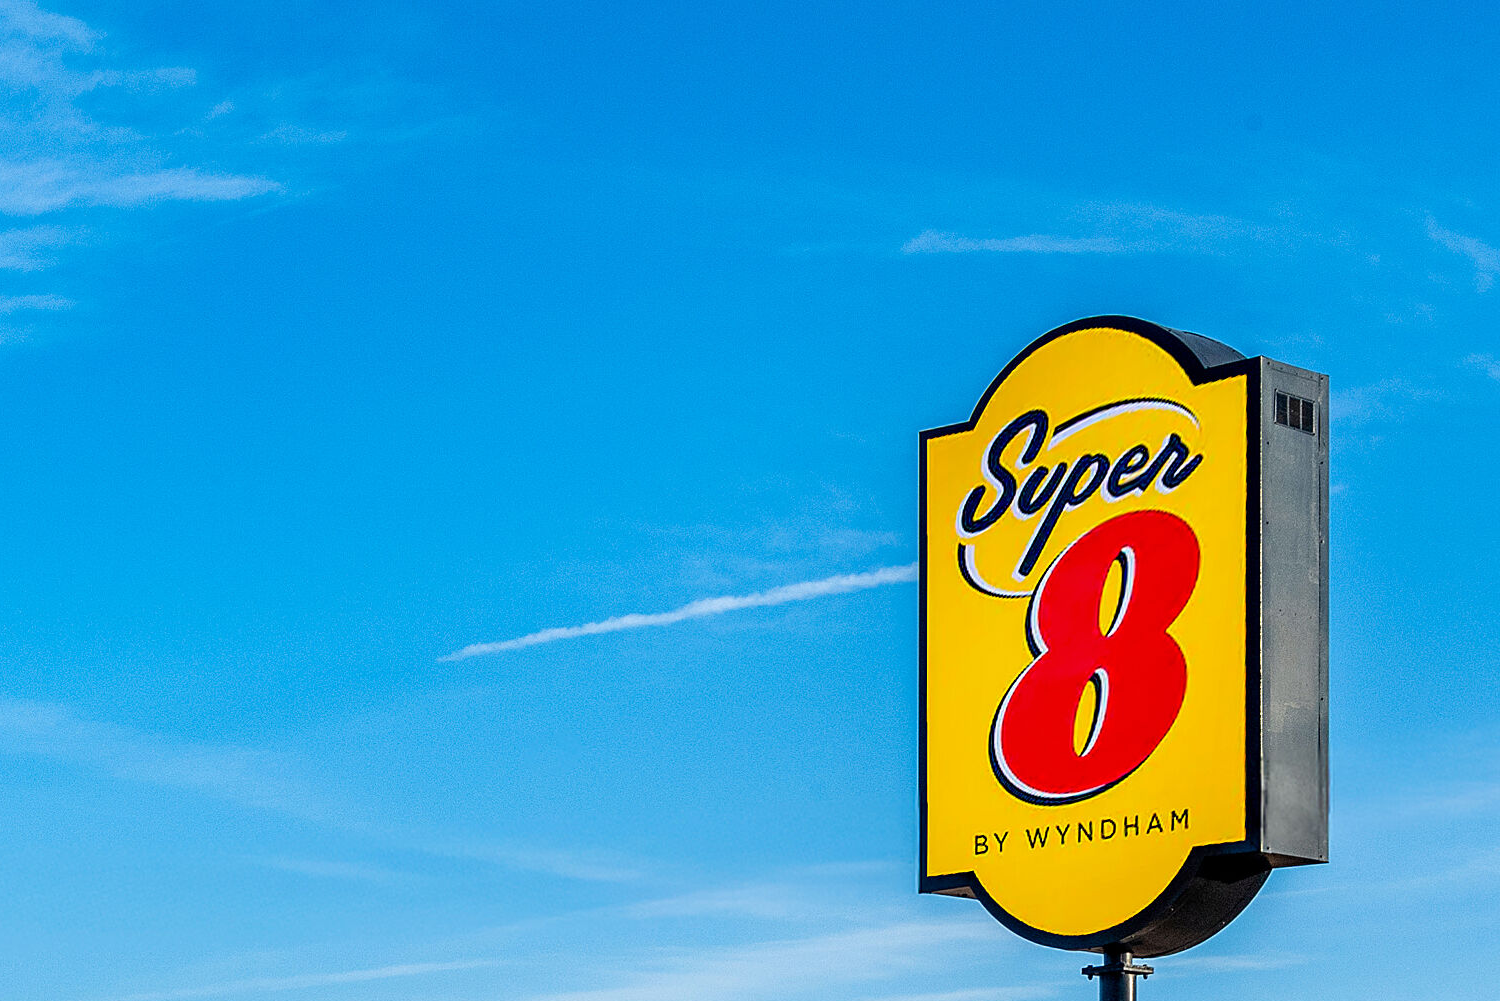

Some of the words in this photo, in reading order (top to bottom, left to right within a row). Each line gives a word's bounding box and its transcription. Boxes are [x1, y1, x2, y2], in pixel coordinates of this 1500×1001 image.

[959, 409, 1202, 579] Super
[989, 510, 1200, 805] 8
[975, 831, 1009, 855] BY
[1026, 809, 1189, 849] WYNDHAM
